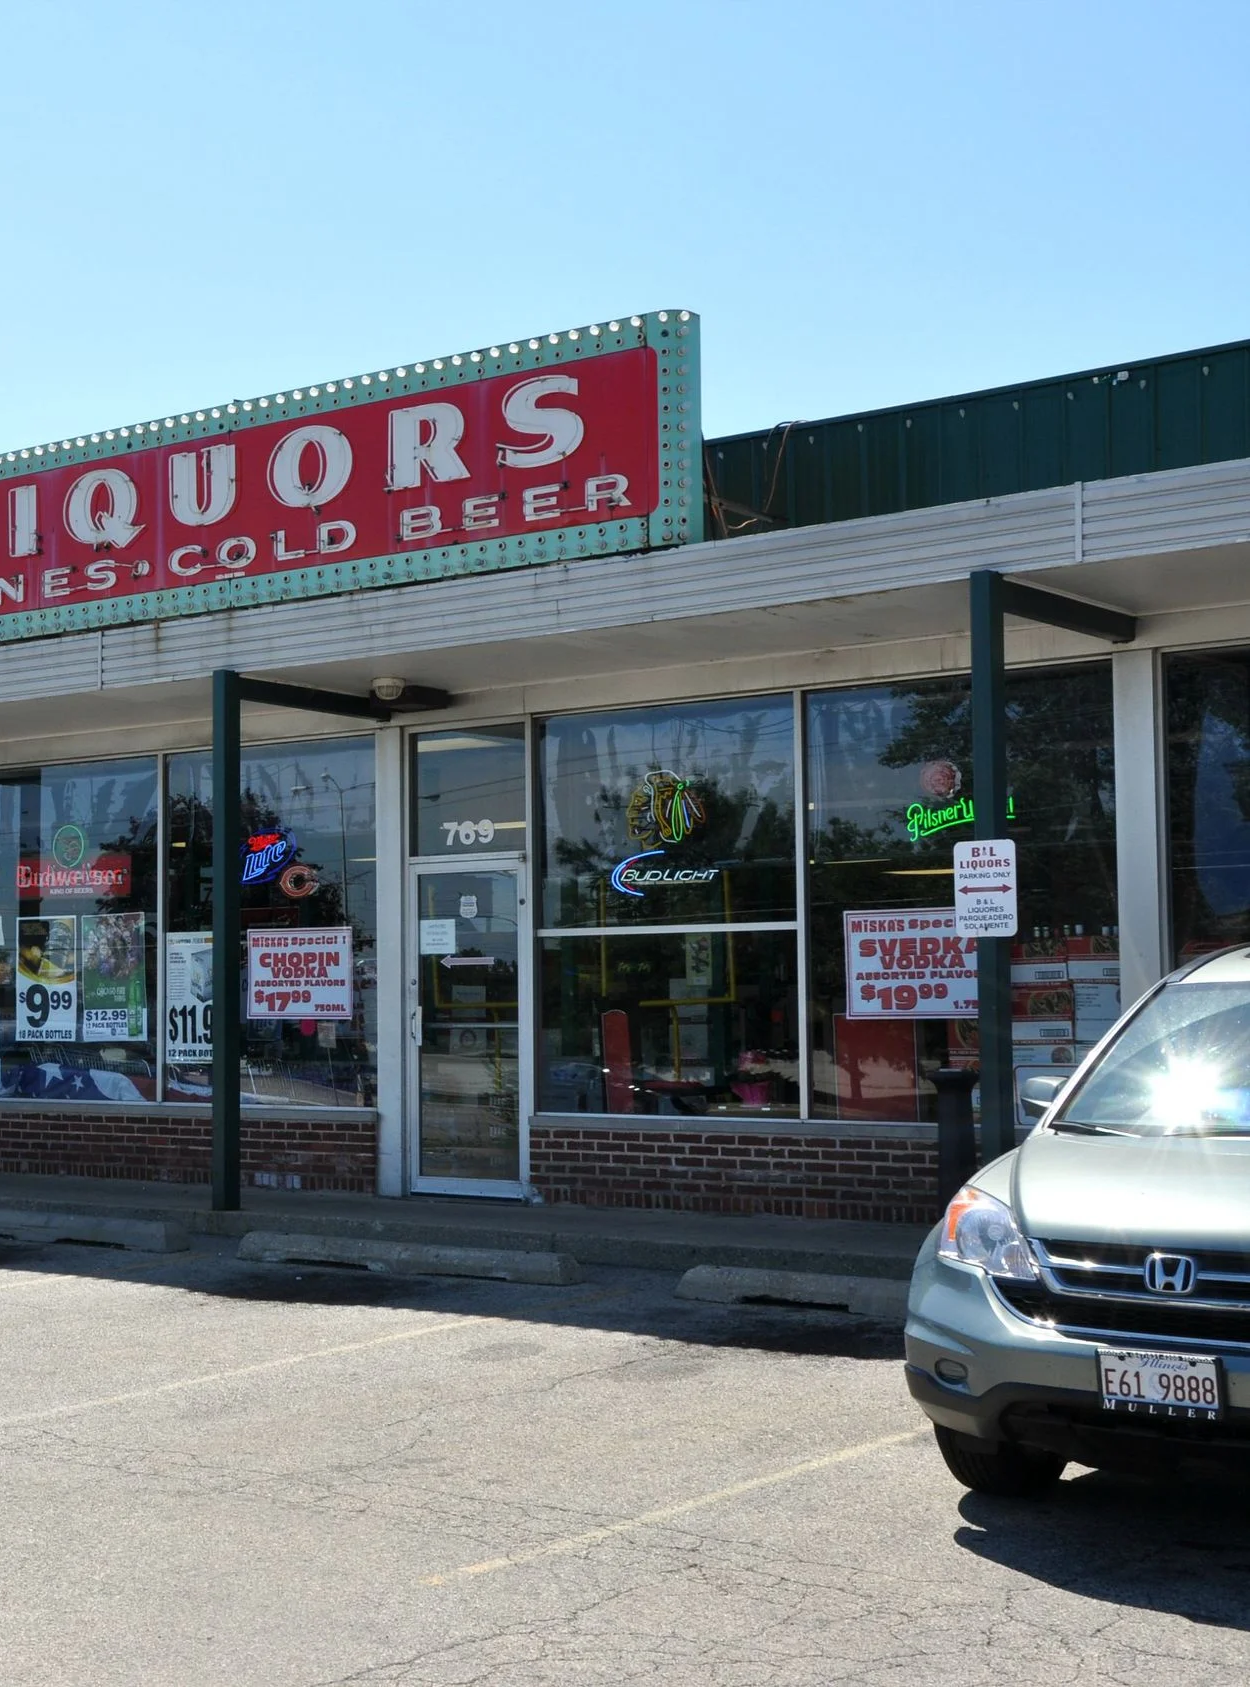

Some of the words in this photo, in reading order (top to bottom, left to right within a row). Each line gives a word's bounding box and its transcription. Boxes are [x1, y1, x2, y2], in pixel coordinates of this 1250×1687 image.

[168, 519, 357, 576] COLD
[400, 474, 632, 541] BEER
[907, 803, 963, 842] Pilsner
[442, 819, 495, 846] 769
[243, 841, 287, 881] Lite
[959, 858, 1010, 870] LIQUORS
[620, 869, 662, 882] BUD
[663, 869, 719, 881] LIGHT
[959, 872, 991, 880] PARKING
[959, 913, 1014, 921] PARQUEADERO
[964, 922, 1010, 930] SOLAMENTE
[291, 935, 338, 947] Special
[858, 936, 978, 957] SVEDKA
[259, 951, 340, 968] CHOPIN
[880, 954, 966, 970] VODKA
[271, 966, 329, 979] VODKA
[855, 971, 926, 981] ASSORTED
[254, 979, 302, 987] ASSORTED
[304, 979, 346, 987] FLAVORS
[314, 1004, 347, 1012] 750ML
[85, 1010, 127, 1021] $12.99
[27, 1030, 44, 1039] PACK
[45, 1029, 73, 1039] BOTTLES
[178, 1049, 197, 1057] PACK
[1104, 1367, 1146, 1399] E61
[1158, 1373, 1216, 1405] 9888
[1102, 1398, 1217, 1420] MULLER
